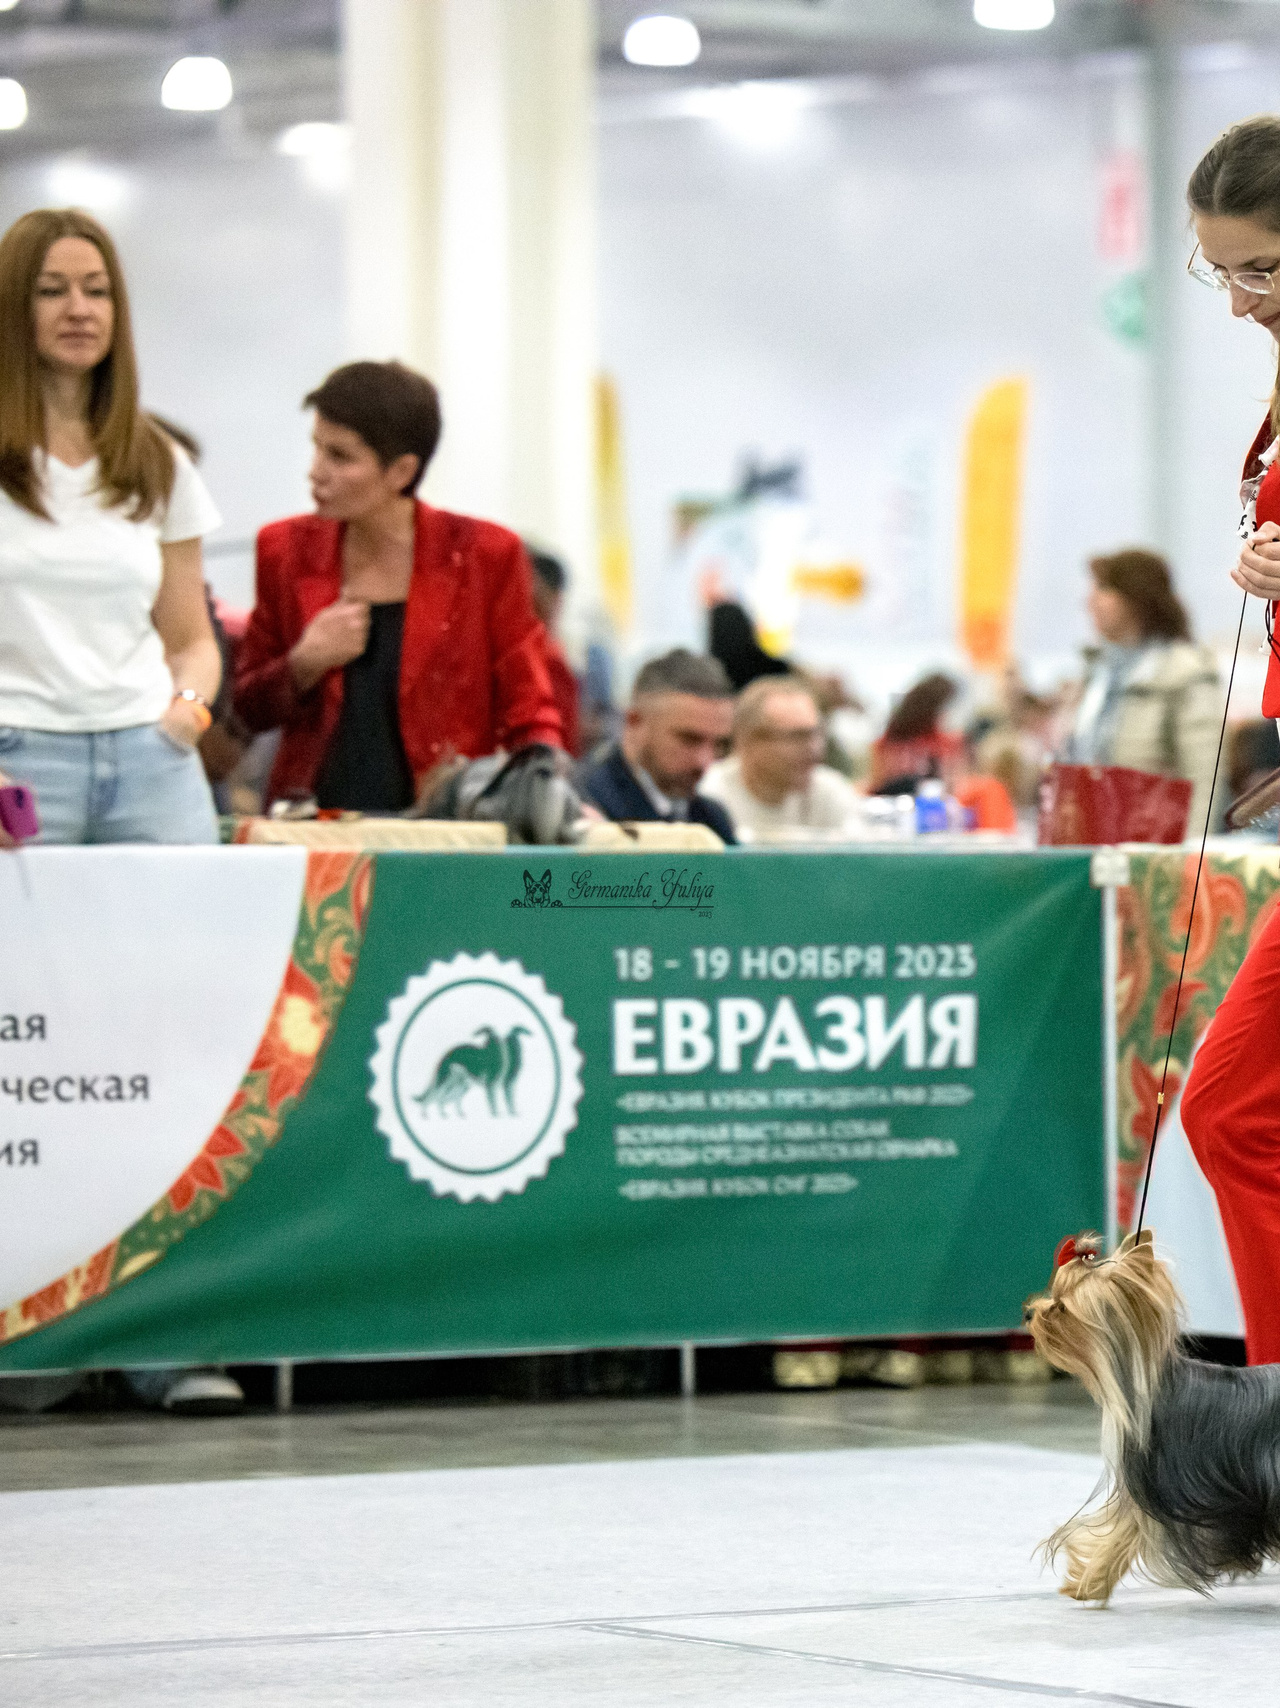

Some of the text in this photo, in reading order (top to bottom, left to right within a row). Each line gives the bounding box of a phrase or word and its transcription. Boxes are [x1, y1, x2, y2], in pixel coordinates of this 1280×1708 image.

[614, 947, 652, 980] 18
[693, 947, 732, 979] 19
[740, 945, 886, 979] НОЯБРЯ
[895, 943, 977, 978] 2023
[613, 995, 978, 1074] ЕВРАЗИЯ
